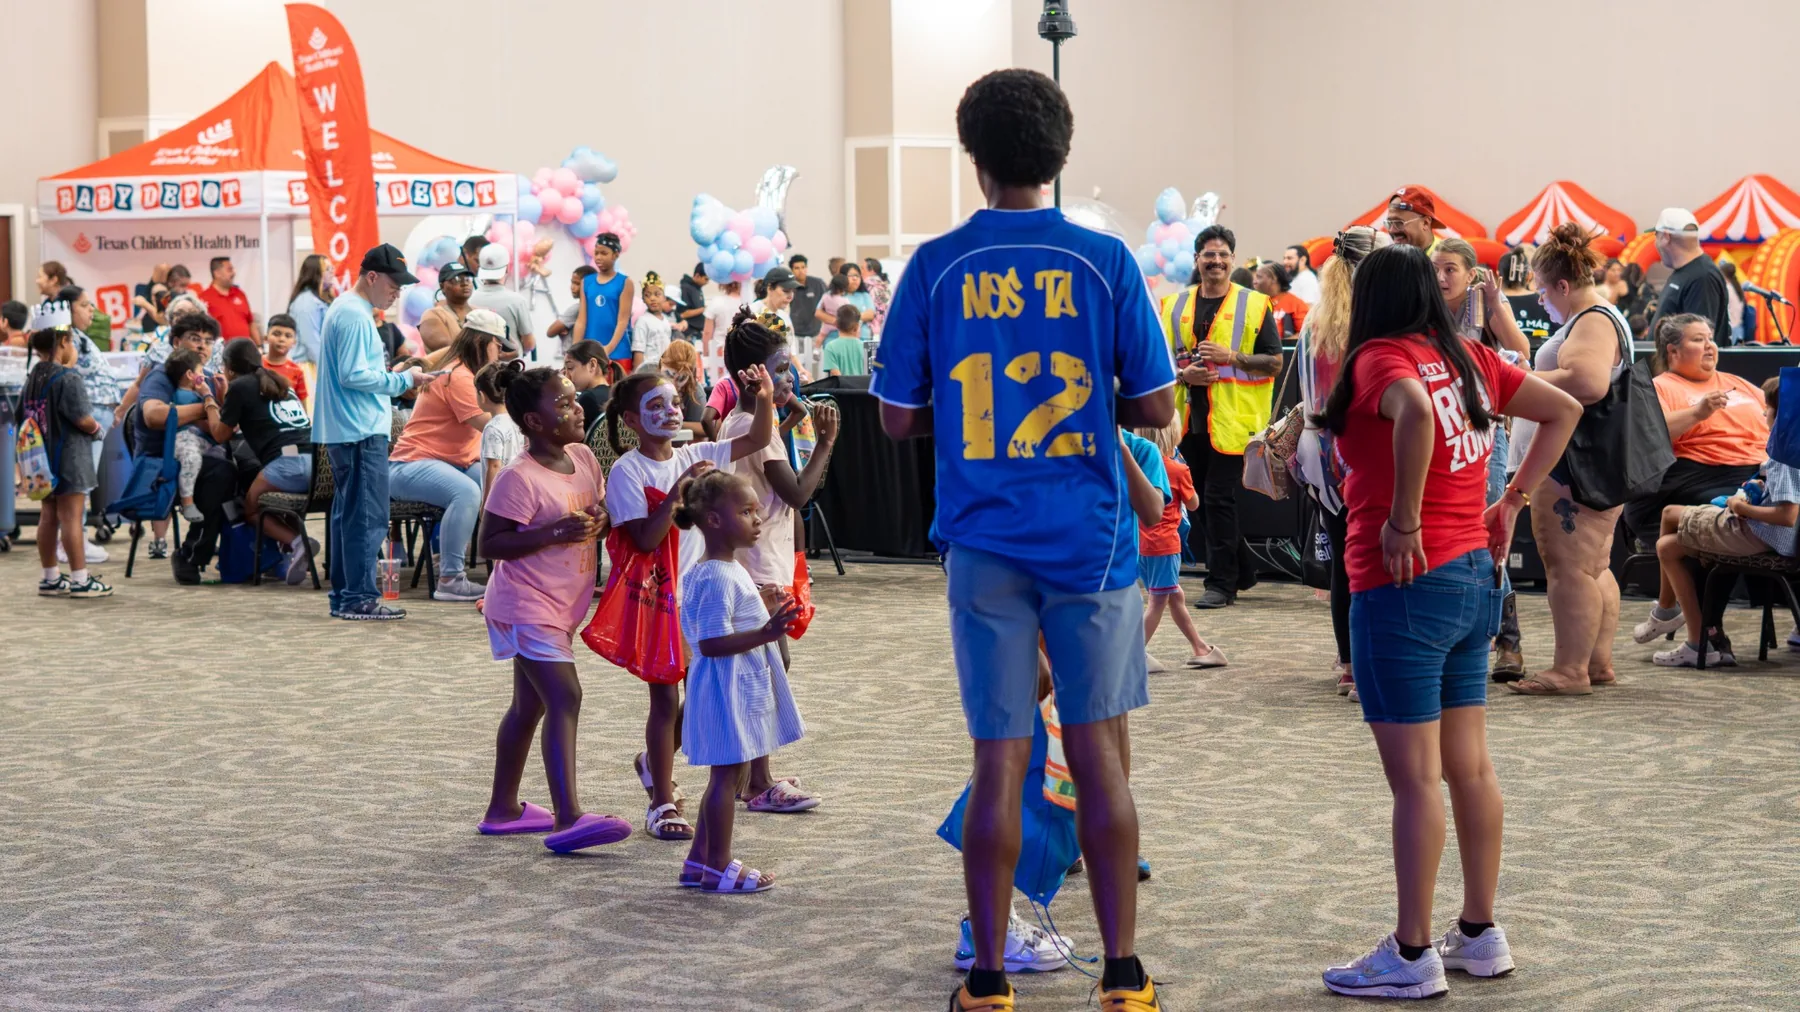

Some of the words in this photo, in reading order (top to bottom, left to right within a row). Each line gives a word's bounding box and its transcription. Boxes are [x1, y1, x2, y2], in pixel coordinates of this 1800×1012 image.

[57, 184, 133, 213] BABY
[141, 179, 241, 210] DEPOT
[312, 82, 352, 293] WELCOM
[388, 180, 497, 207] DEPOT
[95, 235, 129, 250] Texas
[131, 235, 191, 250] Children's
[193, 235, 232, 250] Health
[235, 235, 260, 249] Plan
[962, 267, 1025, 320] NOS
[1034, 269, 1078, 319] TA
[949, 351, 1097, 460] 12
